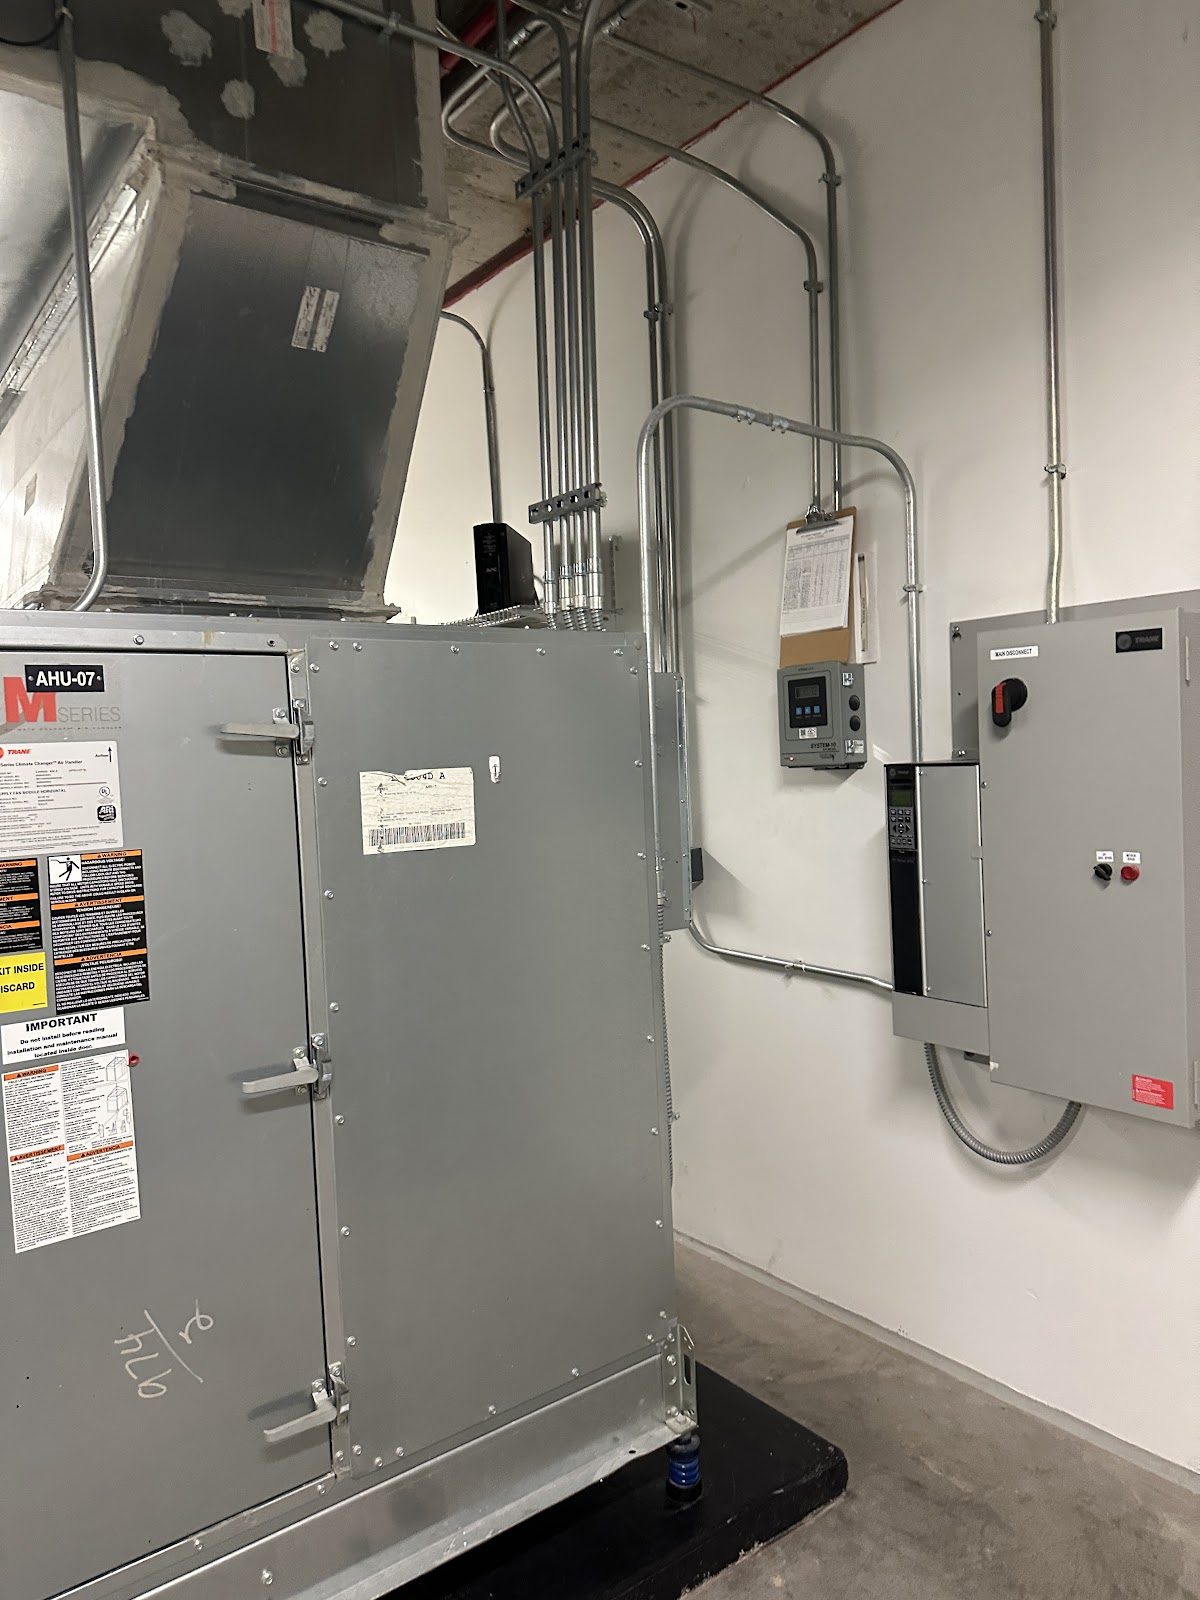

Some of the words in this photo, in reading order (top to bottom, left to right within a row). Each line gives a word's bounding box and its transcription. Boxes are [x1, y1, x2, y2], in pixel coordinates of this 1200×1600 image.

[1006, 648, 1032, 656] DISCONNECT
[36, 671, 95, 686] AHU-07
[3, 677, 57, 723] M
[58, 707, 121, 722] SERIES
[80, 898, 122, 907] AVERTISSEMENT
[86, 952, 122, 961] ADVERTENCIA
[13, 962, 45, 974] INSIDE
[0, 981, 35, 994] ISCARD
[25, 1013, 98, 1032] IMPORTANT
[62, 1030, 82, 1038] before
[82, 1026, 105, 1035] reading
[7, 1046, 43, 1056] installation
[56, 1037, 95, 1047] maintenance
[96, 1032, 118, 1040] manual
[34, 1049, 58, 1058] located
[22, 1068, 47, 1077] WARNING
[18, 1146, 61, 1160] AVERTISSEMENT
[85, 1144, 121, 1157] ADVERTENCIA
